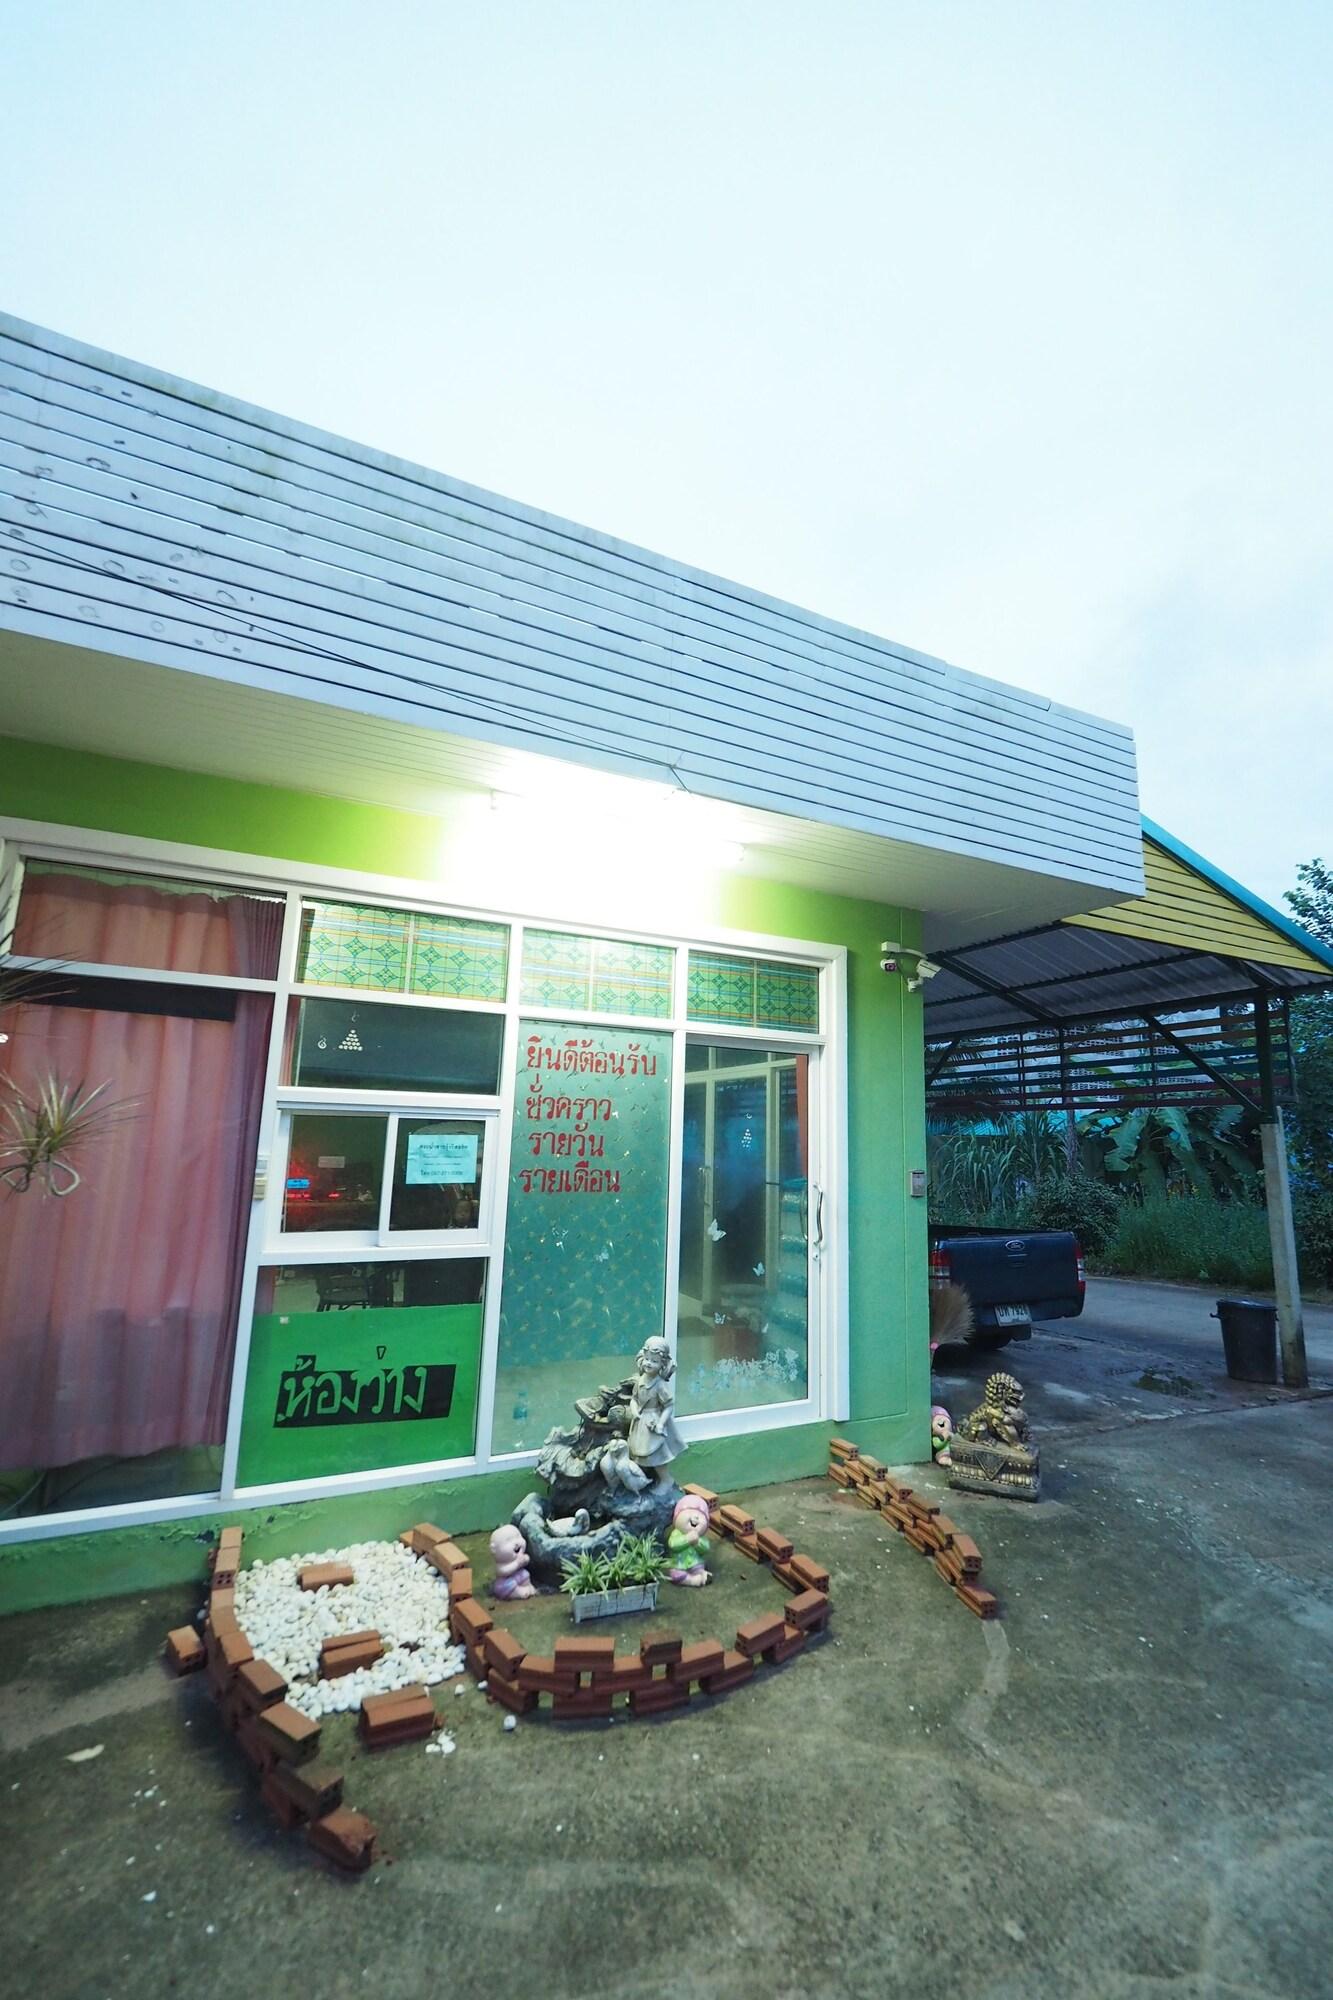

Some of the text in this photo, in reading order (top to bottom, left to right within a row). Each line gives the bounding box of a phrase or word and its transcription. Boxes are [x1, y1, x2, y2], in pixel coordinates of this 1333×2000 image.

[526, 1035, 657, 1076] ยินดีต้อนรับ
[526, 1073, 612, 1120] ชั่วคราว
[528, 1122, 604, 1157] รายวัน
[519, 1160, 621, 1193] รายเดือน
[279, 1345, 428, 1419] ห้องว่าง
